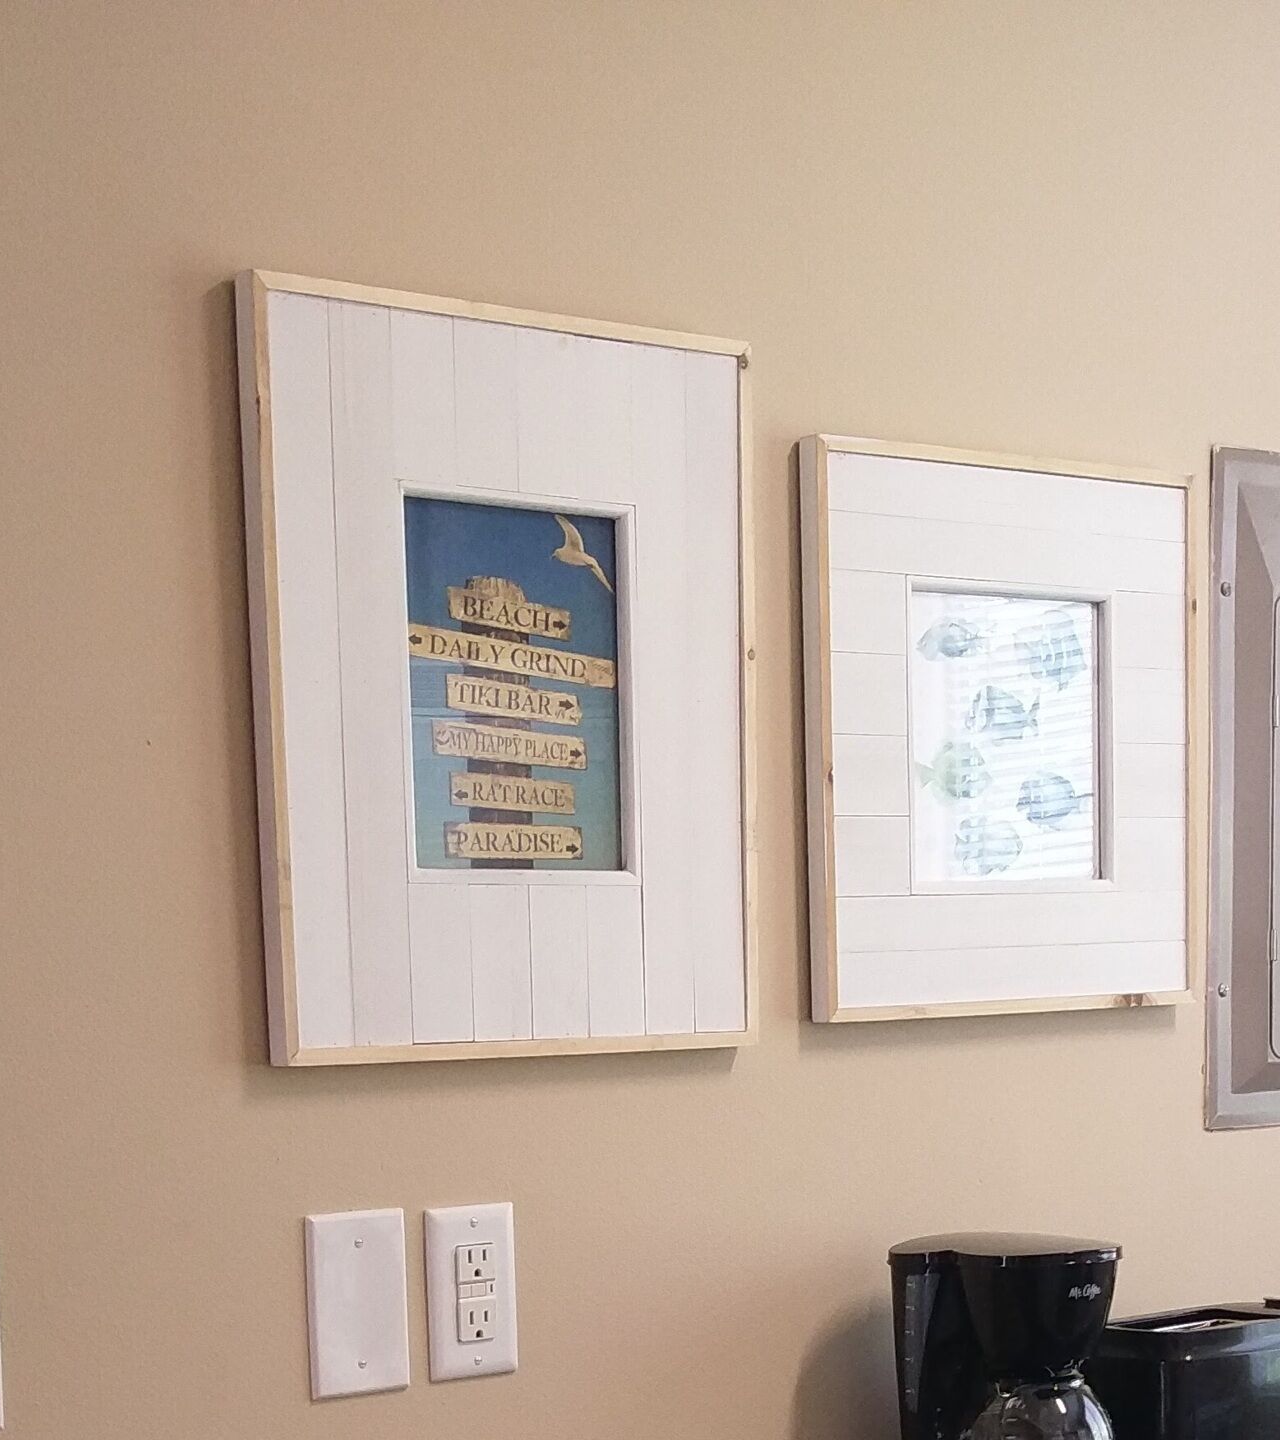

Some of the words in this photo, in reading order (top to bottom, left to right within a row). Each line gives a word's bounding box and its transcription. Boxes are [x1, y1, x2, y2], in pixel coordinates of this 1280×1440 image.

[463, 595, 550, 632] BEACH
[430, 634, 505, 665] DAILY
[510, 647, 587, 678] GRIND
[454, 681, 501, 709] TIKI
[507, 689, 552, 716] BAR
[449, 728, 470, 750] MY
[474, 732, 522, 757] HAPPY
[525, 739, 569, 761] PLACE
[472, 782, 512, 803] RAT
[515, 785, 566, 807] RACE
[456, 831, 563, 853] PARADISE
